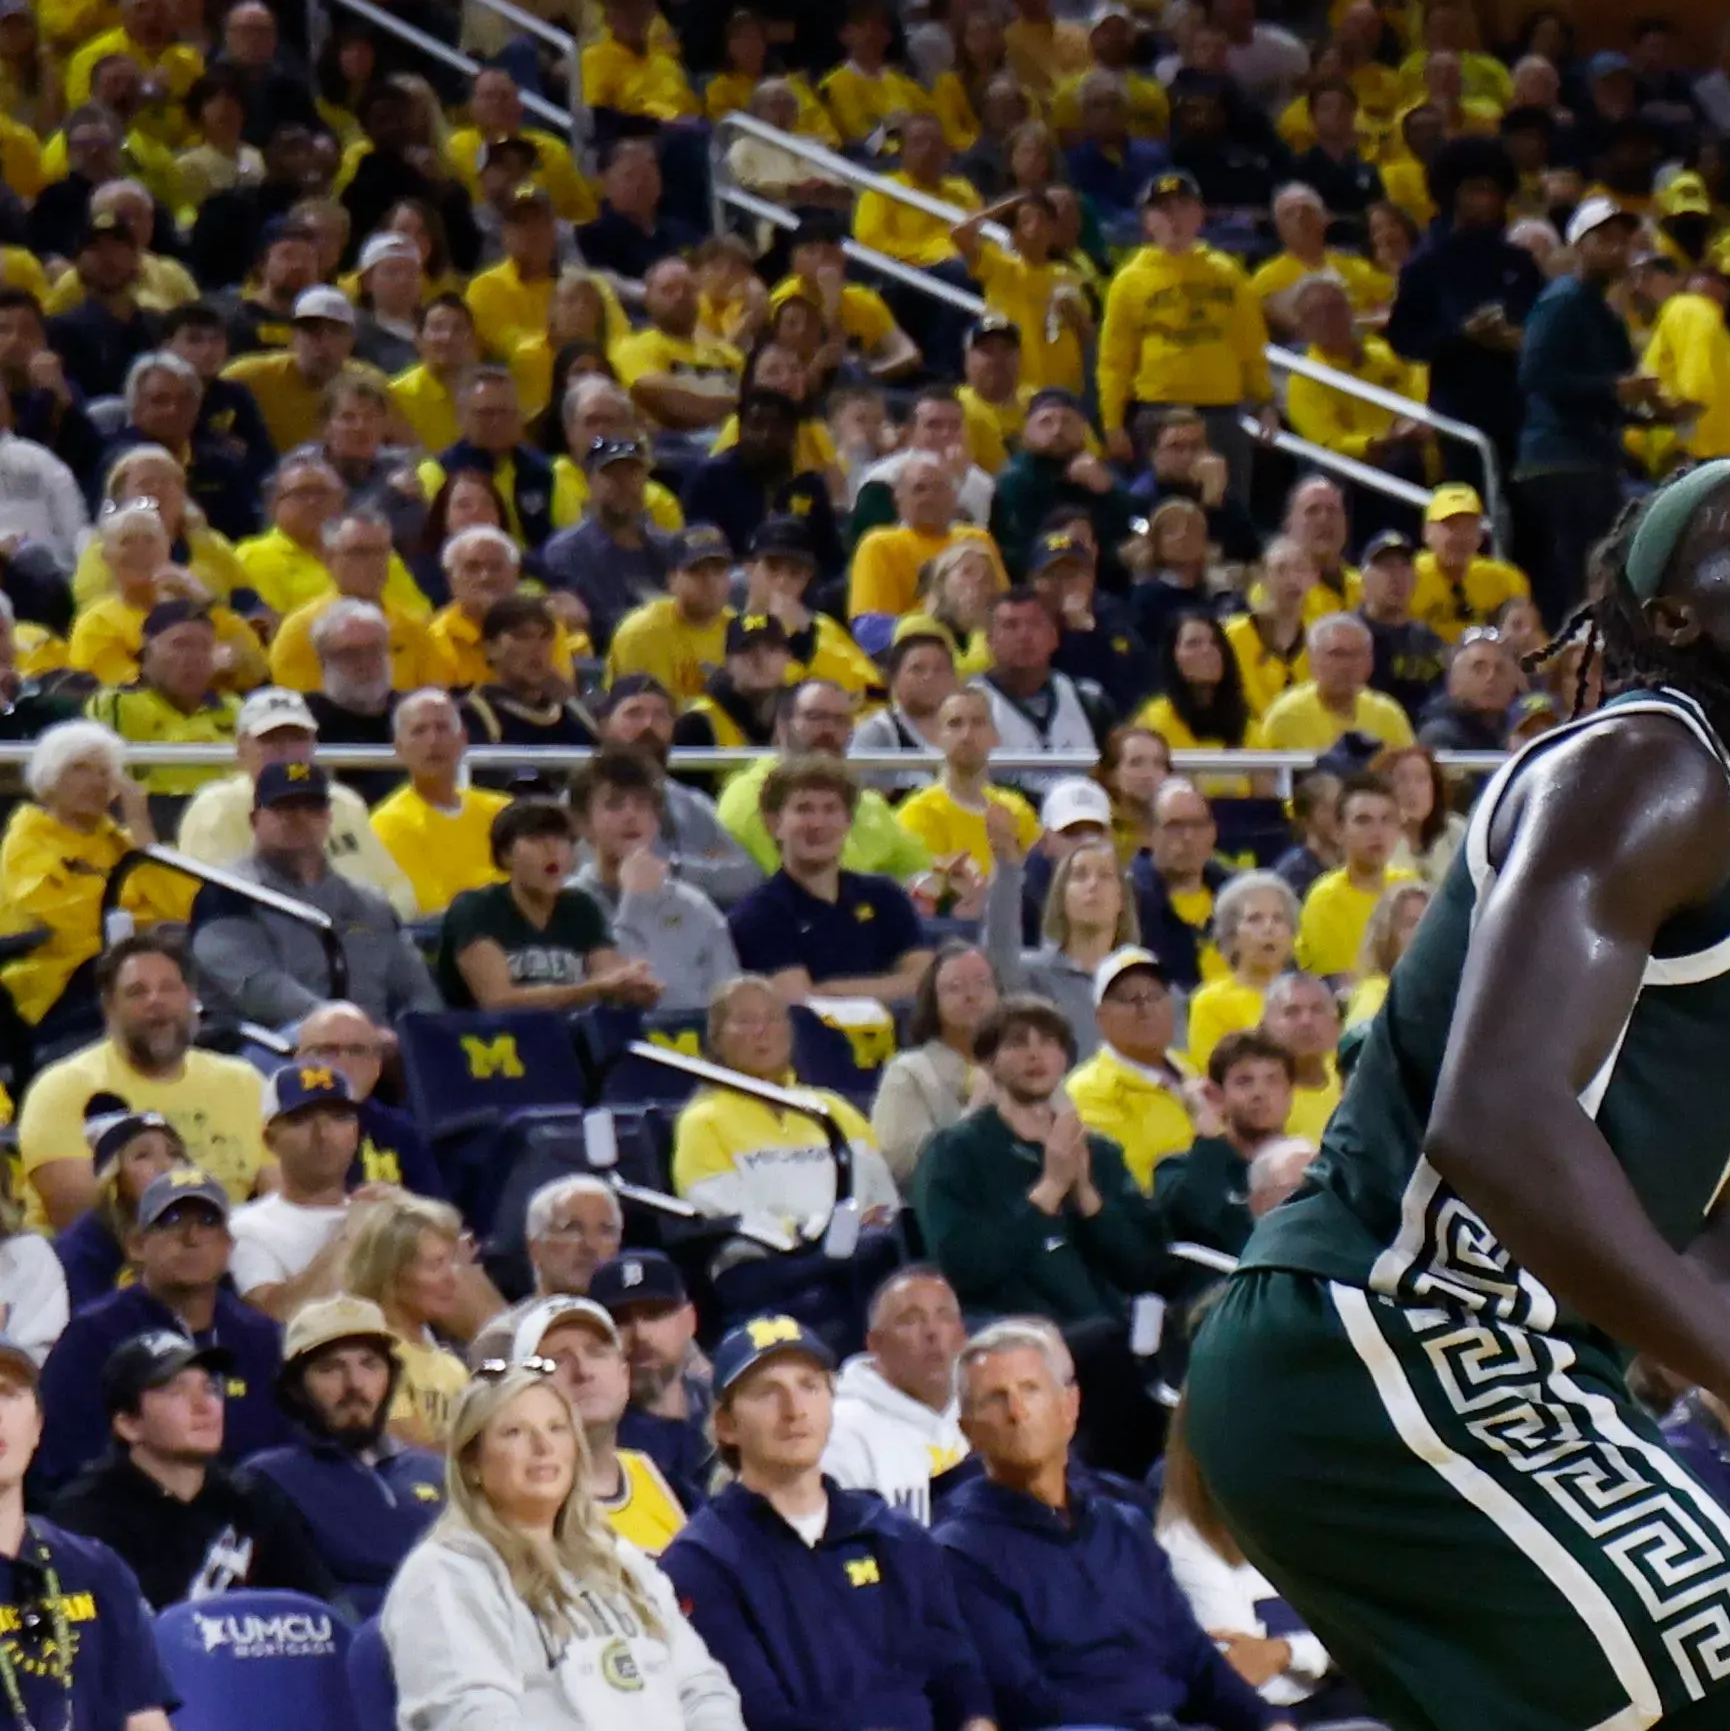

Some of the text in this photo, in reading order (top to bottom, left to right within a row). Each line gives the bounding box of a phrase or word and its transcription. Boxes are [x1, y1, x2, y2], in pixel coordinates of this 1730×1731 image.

[459, 1032, 525, 1080] M
[746, 1314, 802, 1351] M
[225, 1613, 333, 1644] UMCU
